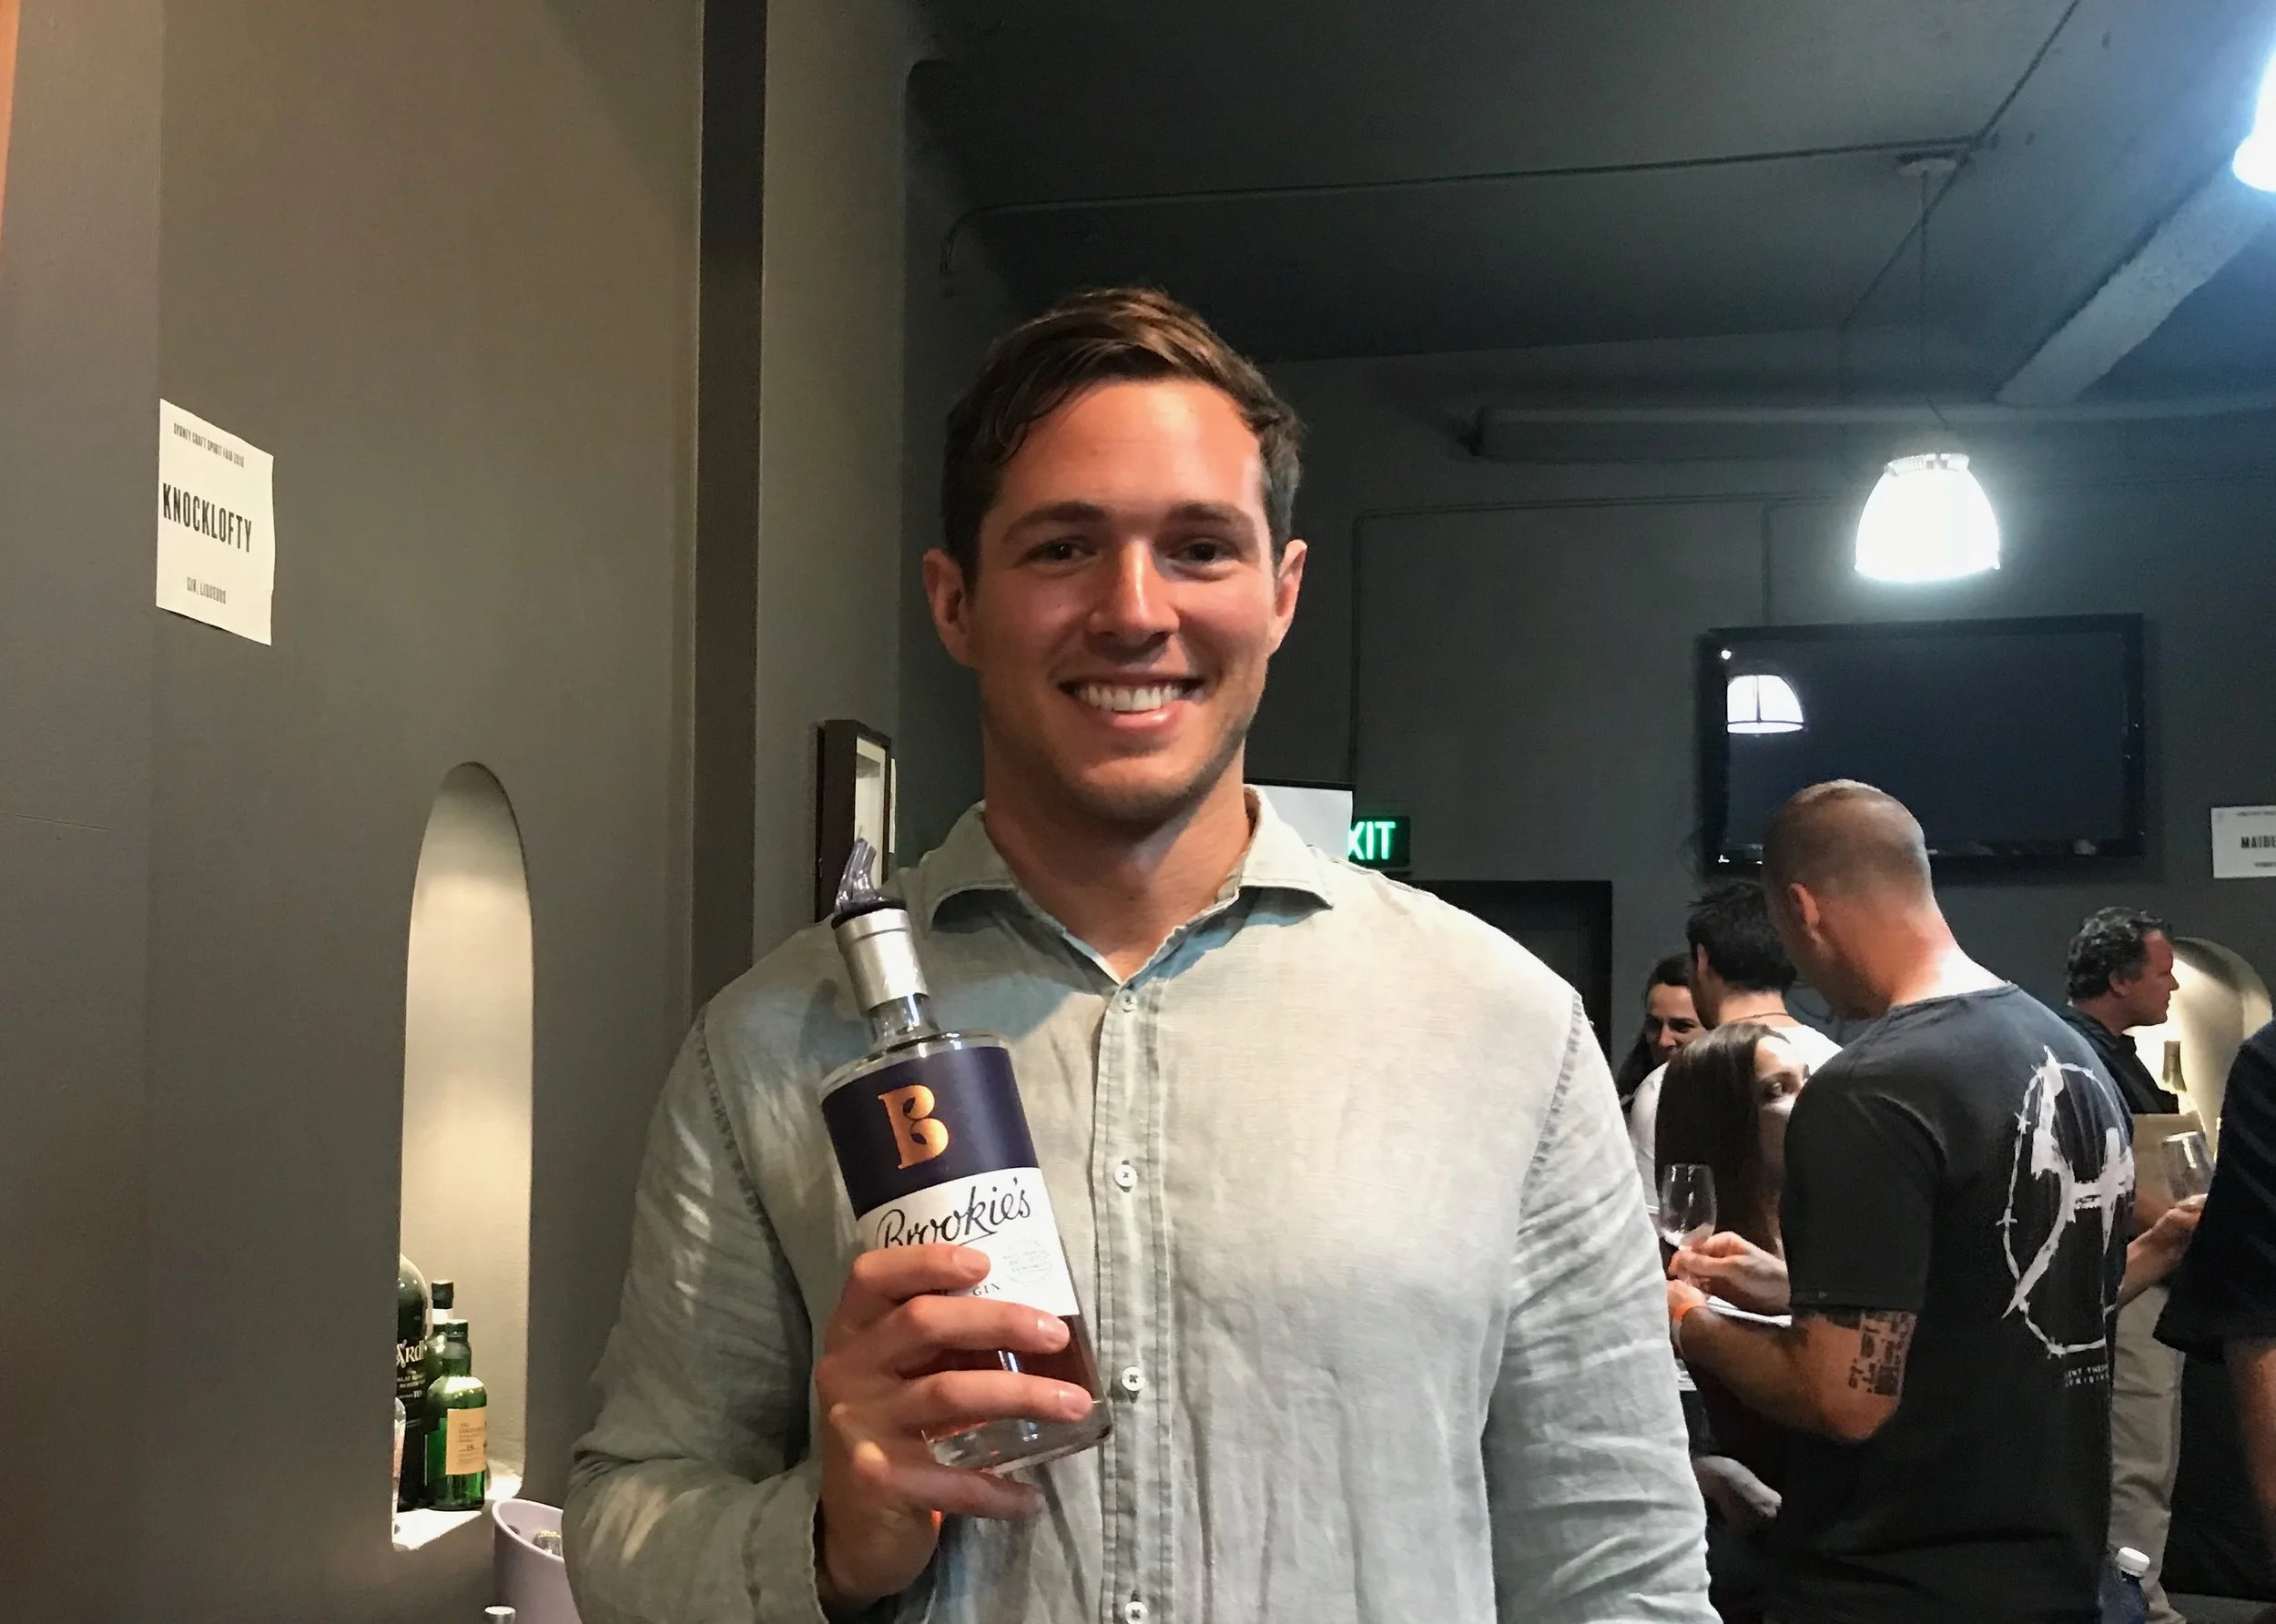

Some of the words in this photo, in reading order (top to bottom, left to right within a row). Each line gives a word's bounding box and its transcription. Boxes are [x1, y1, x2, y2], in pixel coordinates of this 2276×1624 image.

[162, 482, 252, 553] KNOCKLOFTY
[1348, 821, 1396, 860] XIT
[878, 1084, 950, 1170] B
[875, 1177, 1031, 1249] Brookie's
